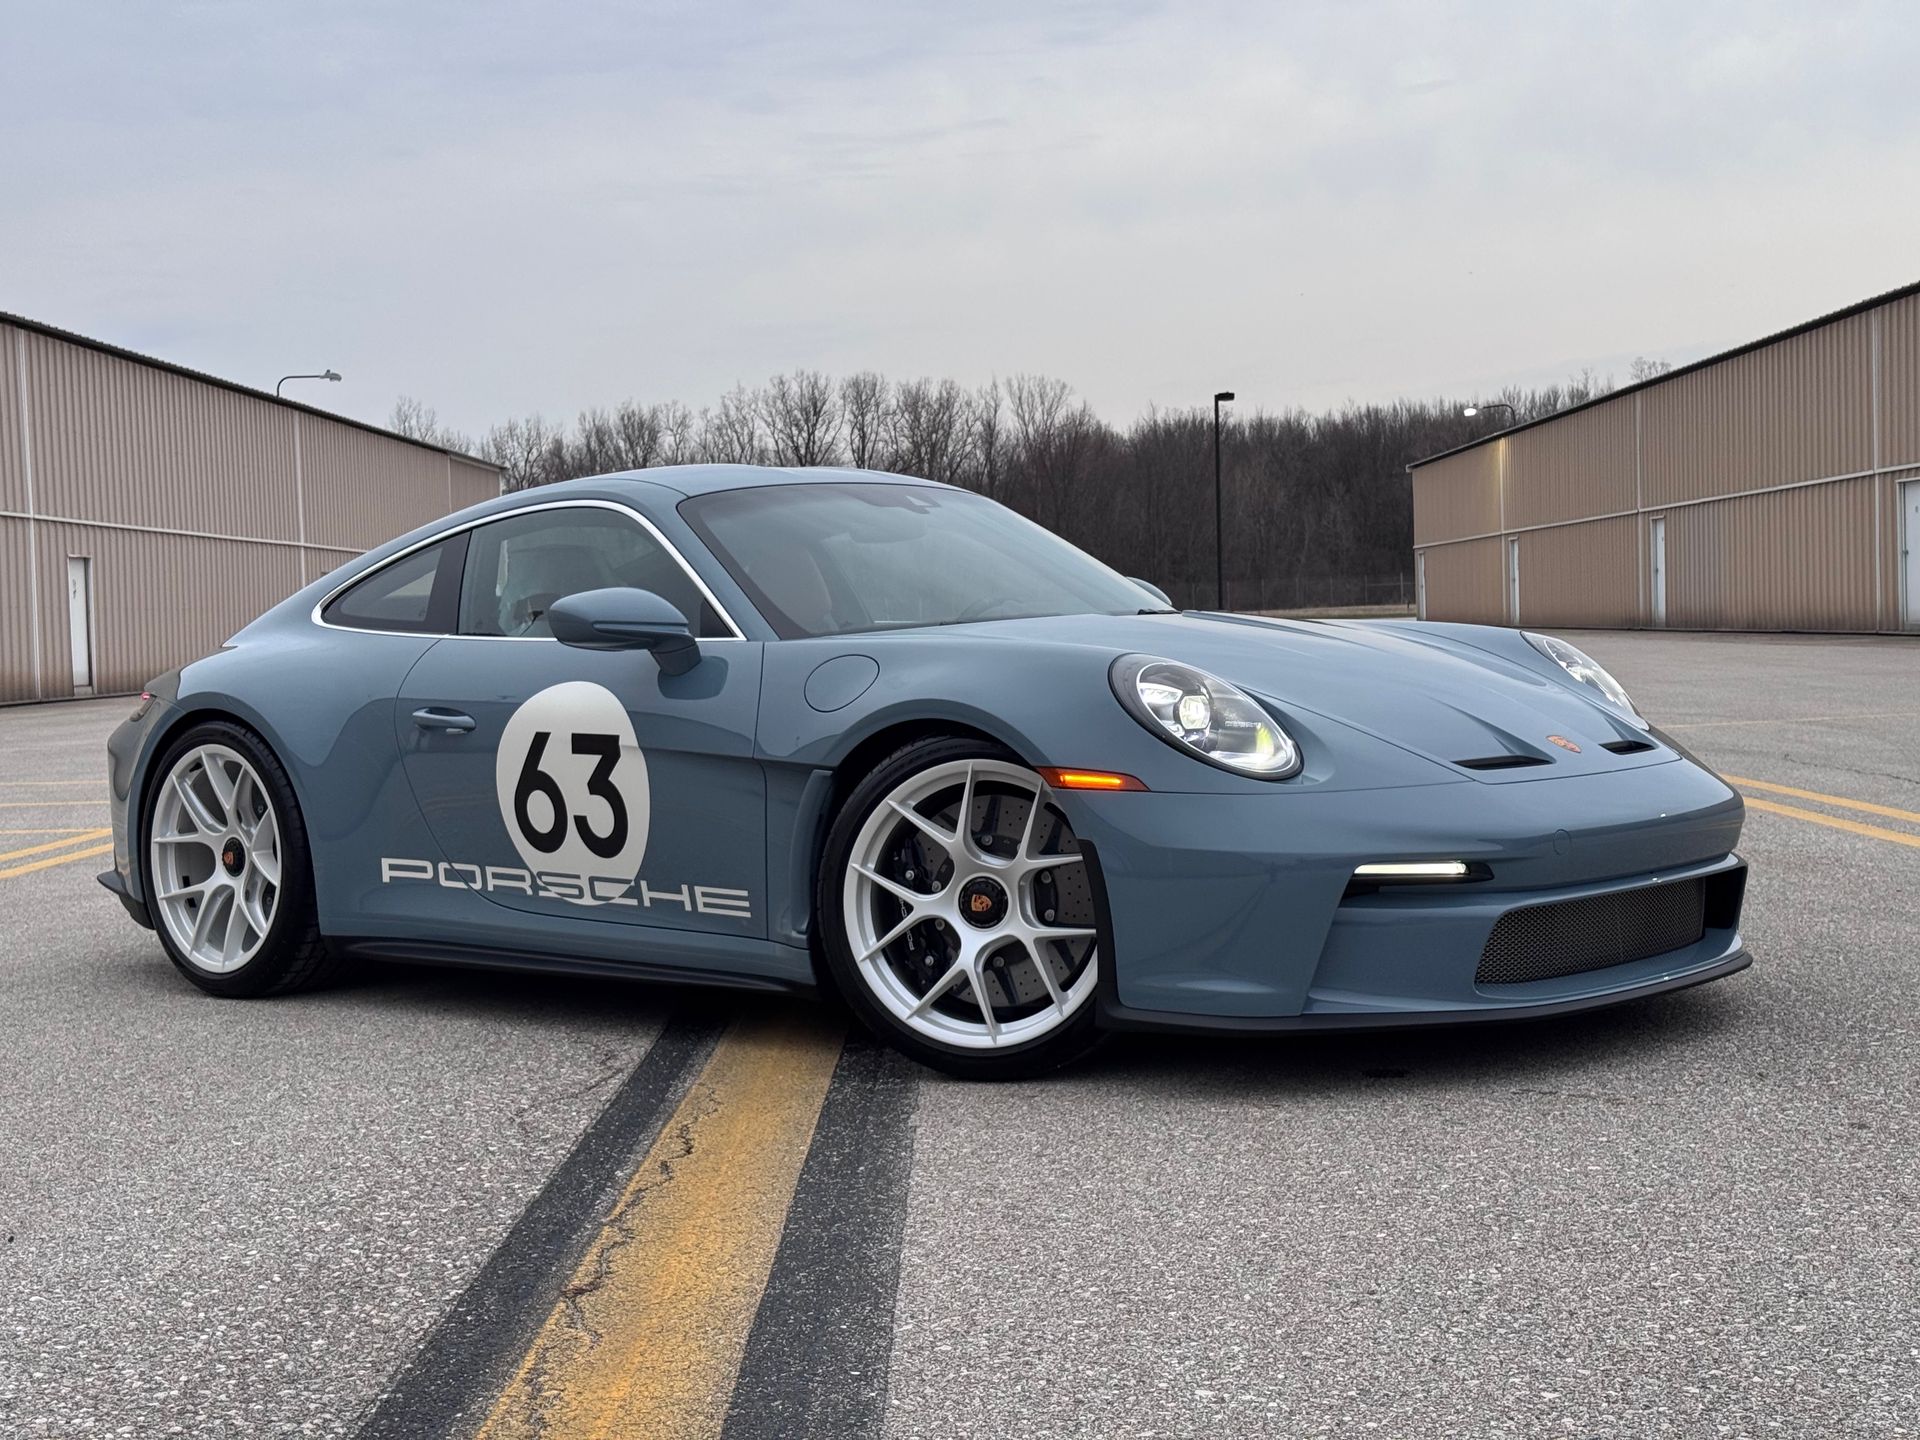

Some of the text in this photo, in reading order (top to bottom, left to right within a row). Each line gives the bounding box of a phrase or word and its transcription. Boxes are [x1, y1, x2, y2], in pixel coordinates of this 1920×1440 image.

[514, 731, 629, 859] 63
[381, 857, 752, 918] PORSCHE
[899, 897, 915, 951] POCH
